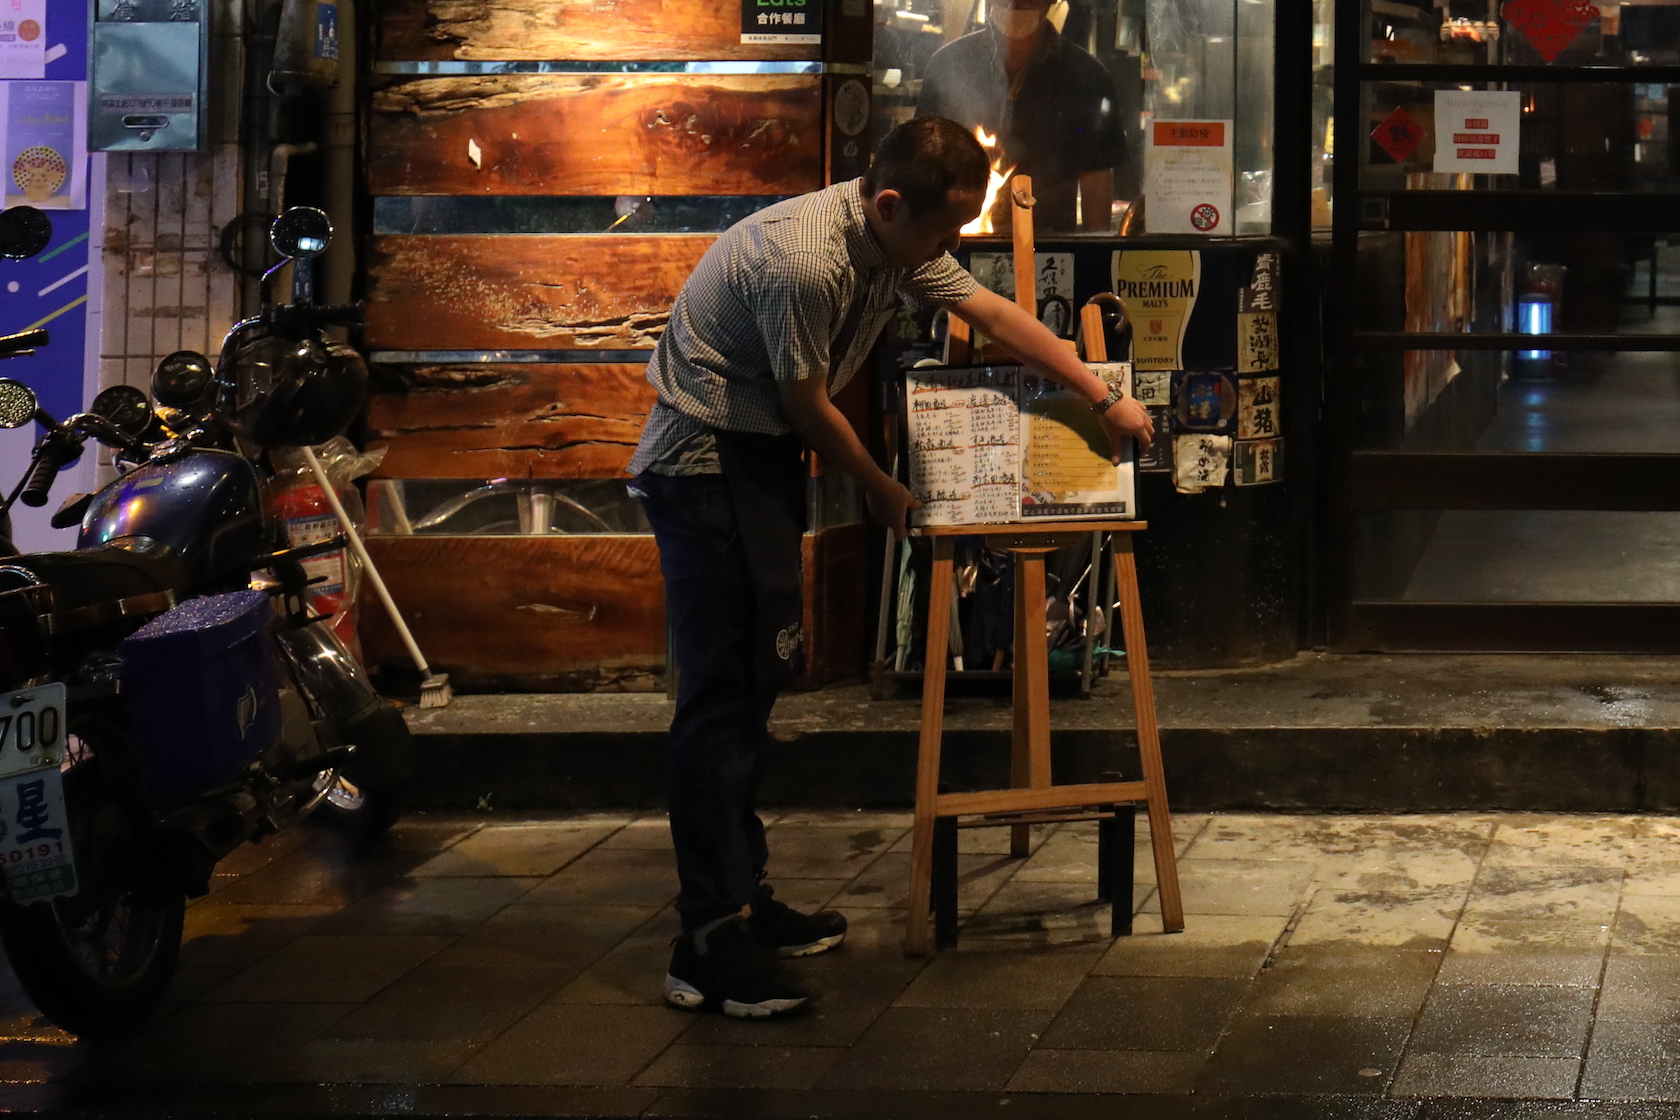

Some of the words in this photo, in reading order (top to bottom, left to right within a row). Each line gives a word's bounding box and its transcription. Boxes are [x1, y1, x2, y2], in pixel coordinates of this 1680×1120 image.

[757, 12, 806, 25] 合作餐廳
[1170, 128, 1209, 139] 主動防疫
[1117, 279, 1194, 298] PREMIUM
